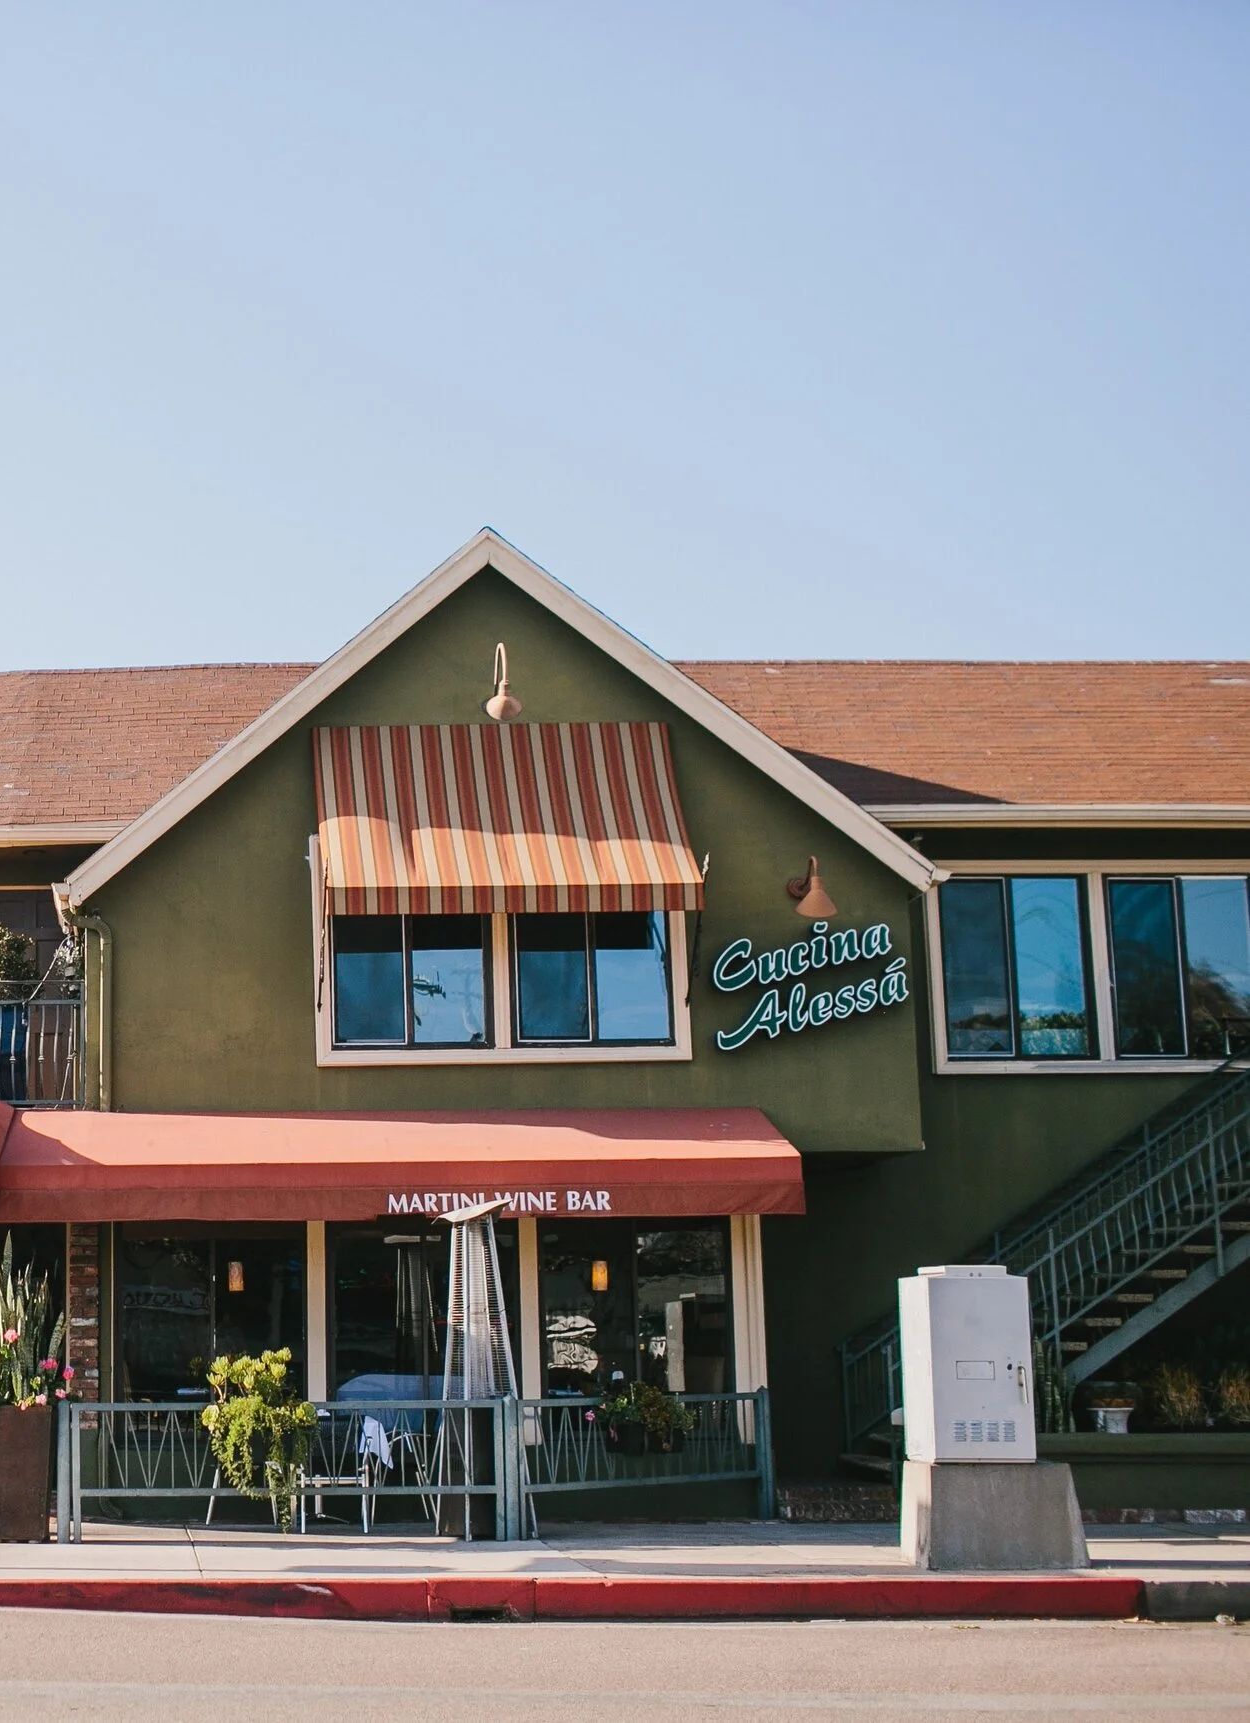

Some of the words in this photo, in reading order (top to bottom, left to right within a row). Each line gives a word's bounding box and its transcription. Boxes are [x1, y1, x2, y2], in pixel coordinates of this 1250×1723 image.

[713, 921, 892, 991] Cucina
[717, 957, 909, 1050] Alessá
[388, 1192, 485, 1213] MARTINI
[494, 1191, 557, 1211] WINE
[567, 1190, 612, 1211] BAR
